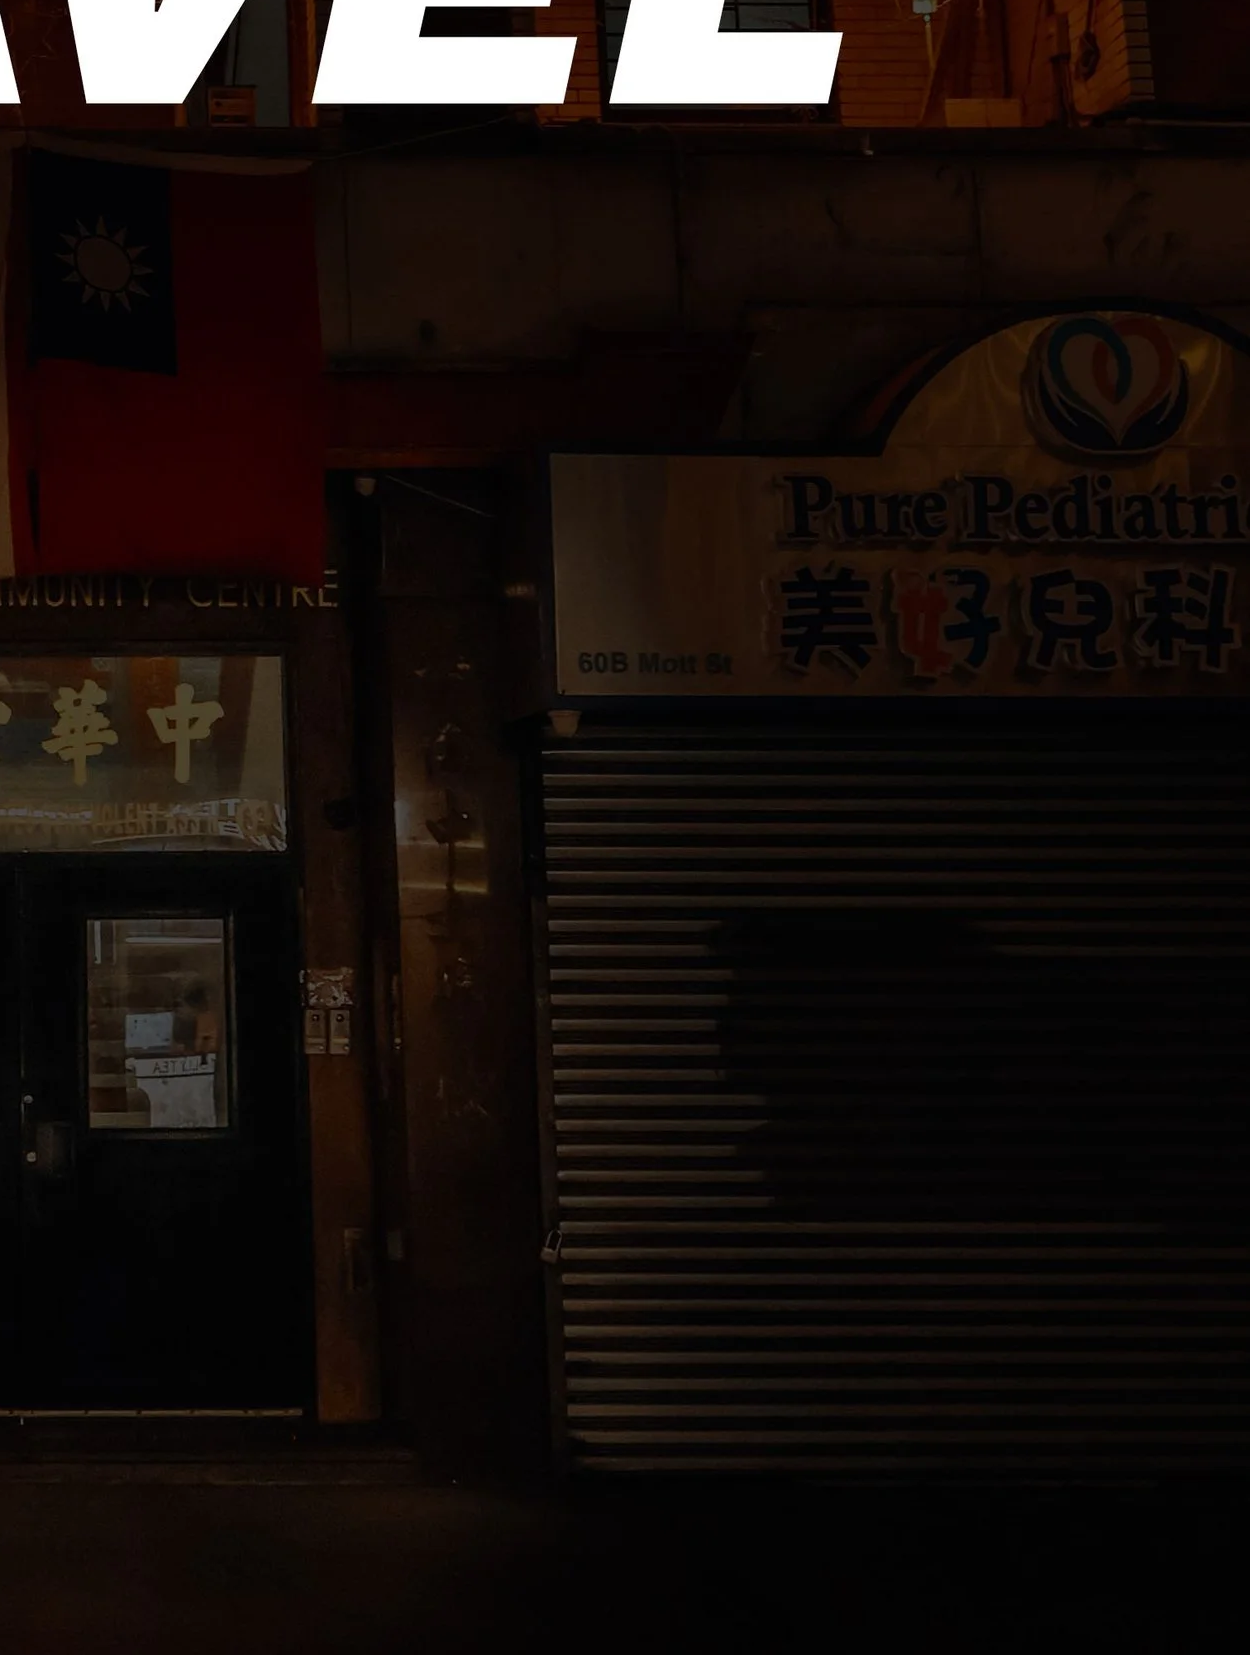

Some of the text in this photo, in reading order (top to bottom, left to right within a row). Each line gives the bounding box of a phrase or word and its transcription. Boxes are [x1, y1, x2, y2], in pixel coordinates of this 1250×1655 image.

[782, 474, 1250, 540] Pure Pediatri
[780, 565, 1236, 677] 美好兒科
[578, 651, 735, 676] 60B Mott St
